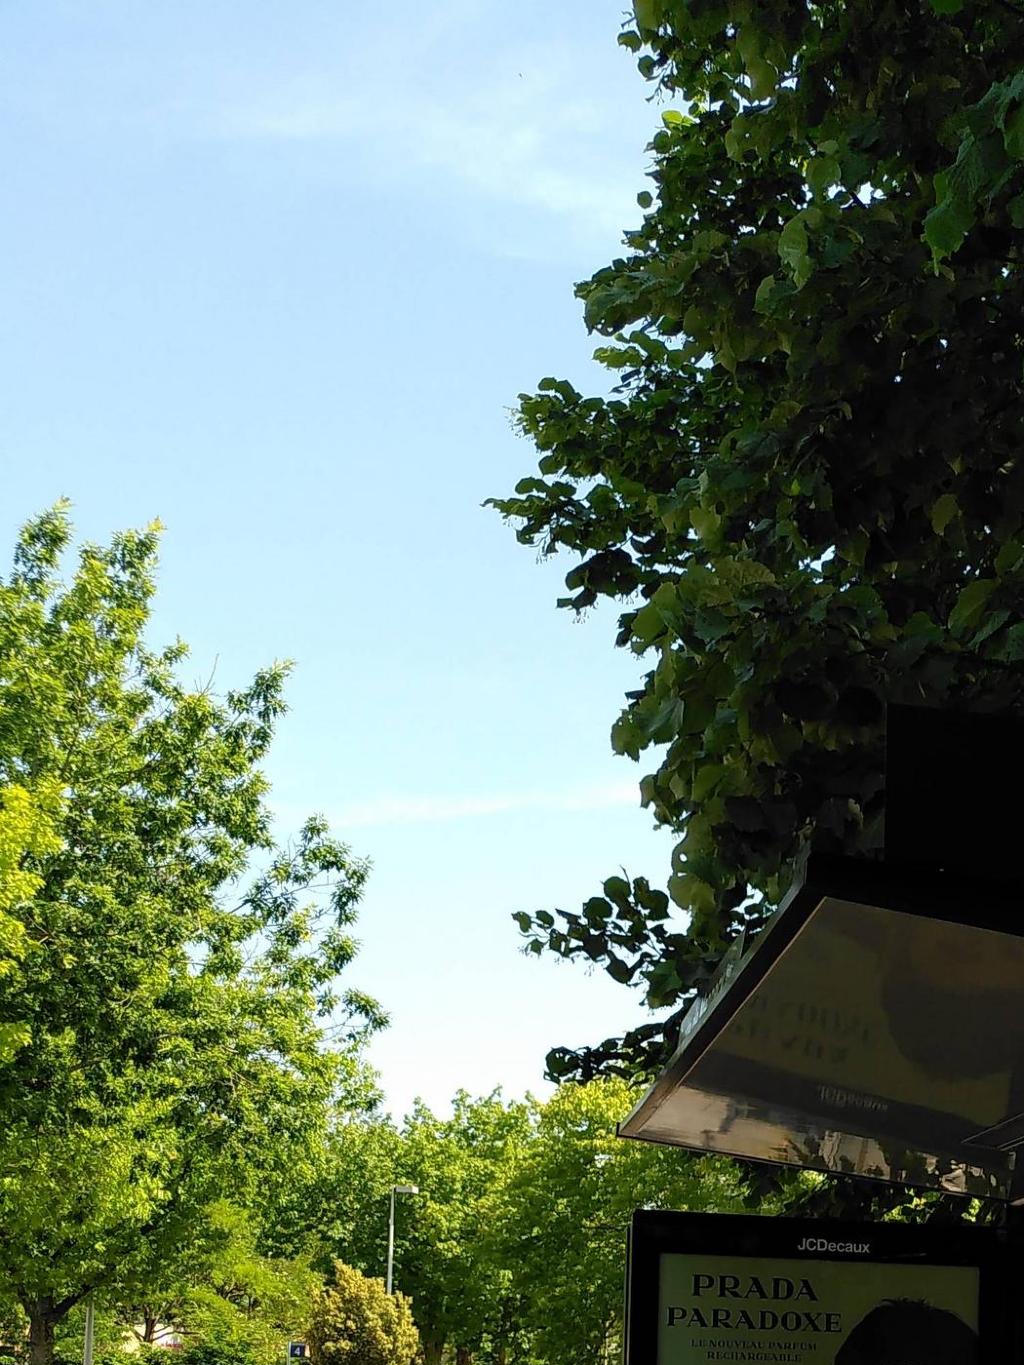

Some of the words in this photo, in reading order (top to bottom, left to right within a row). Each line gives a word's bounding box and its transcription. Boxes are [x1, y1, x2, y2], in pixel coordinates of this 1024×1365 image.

[797, 1237, 871, 1254] JCDecaux
[691, 1273, 818, 1302] PRADA
[667, 1306, 842, 1333] PARADOXE
[691, 1339, 706, 1348] LE
[709, 1339, 764, 1350] NOUVEAU
[768, 1341, 817, 1352] PARFUM
[706, 1351, 801, 1362] RECHARGEABLE
